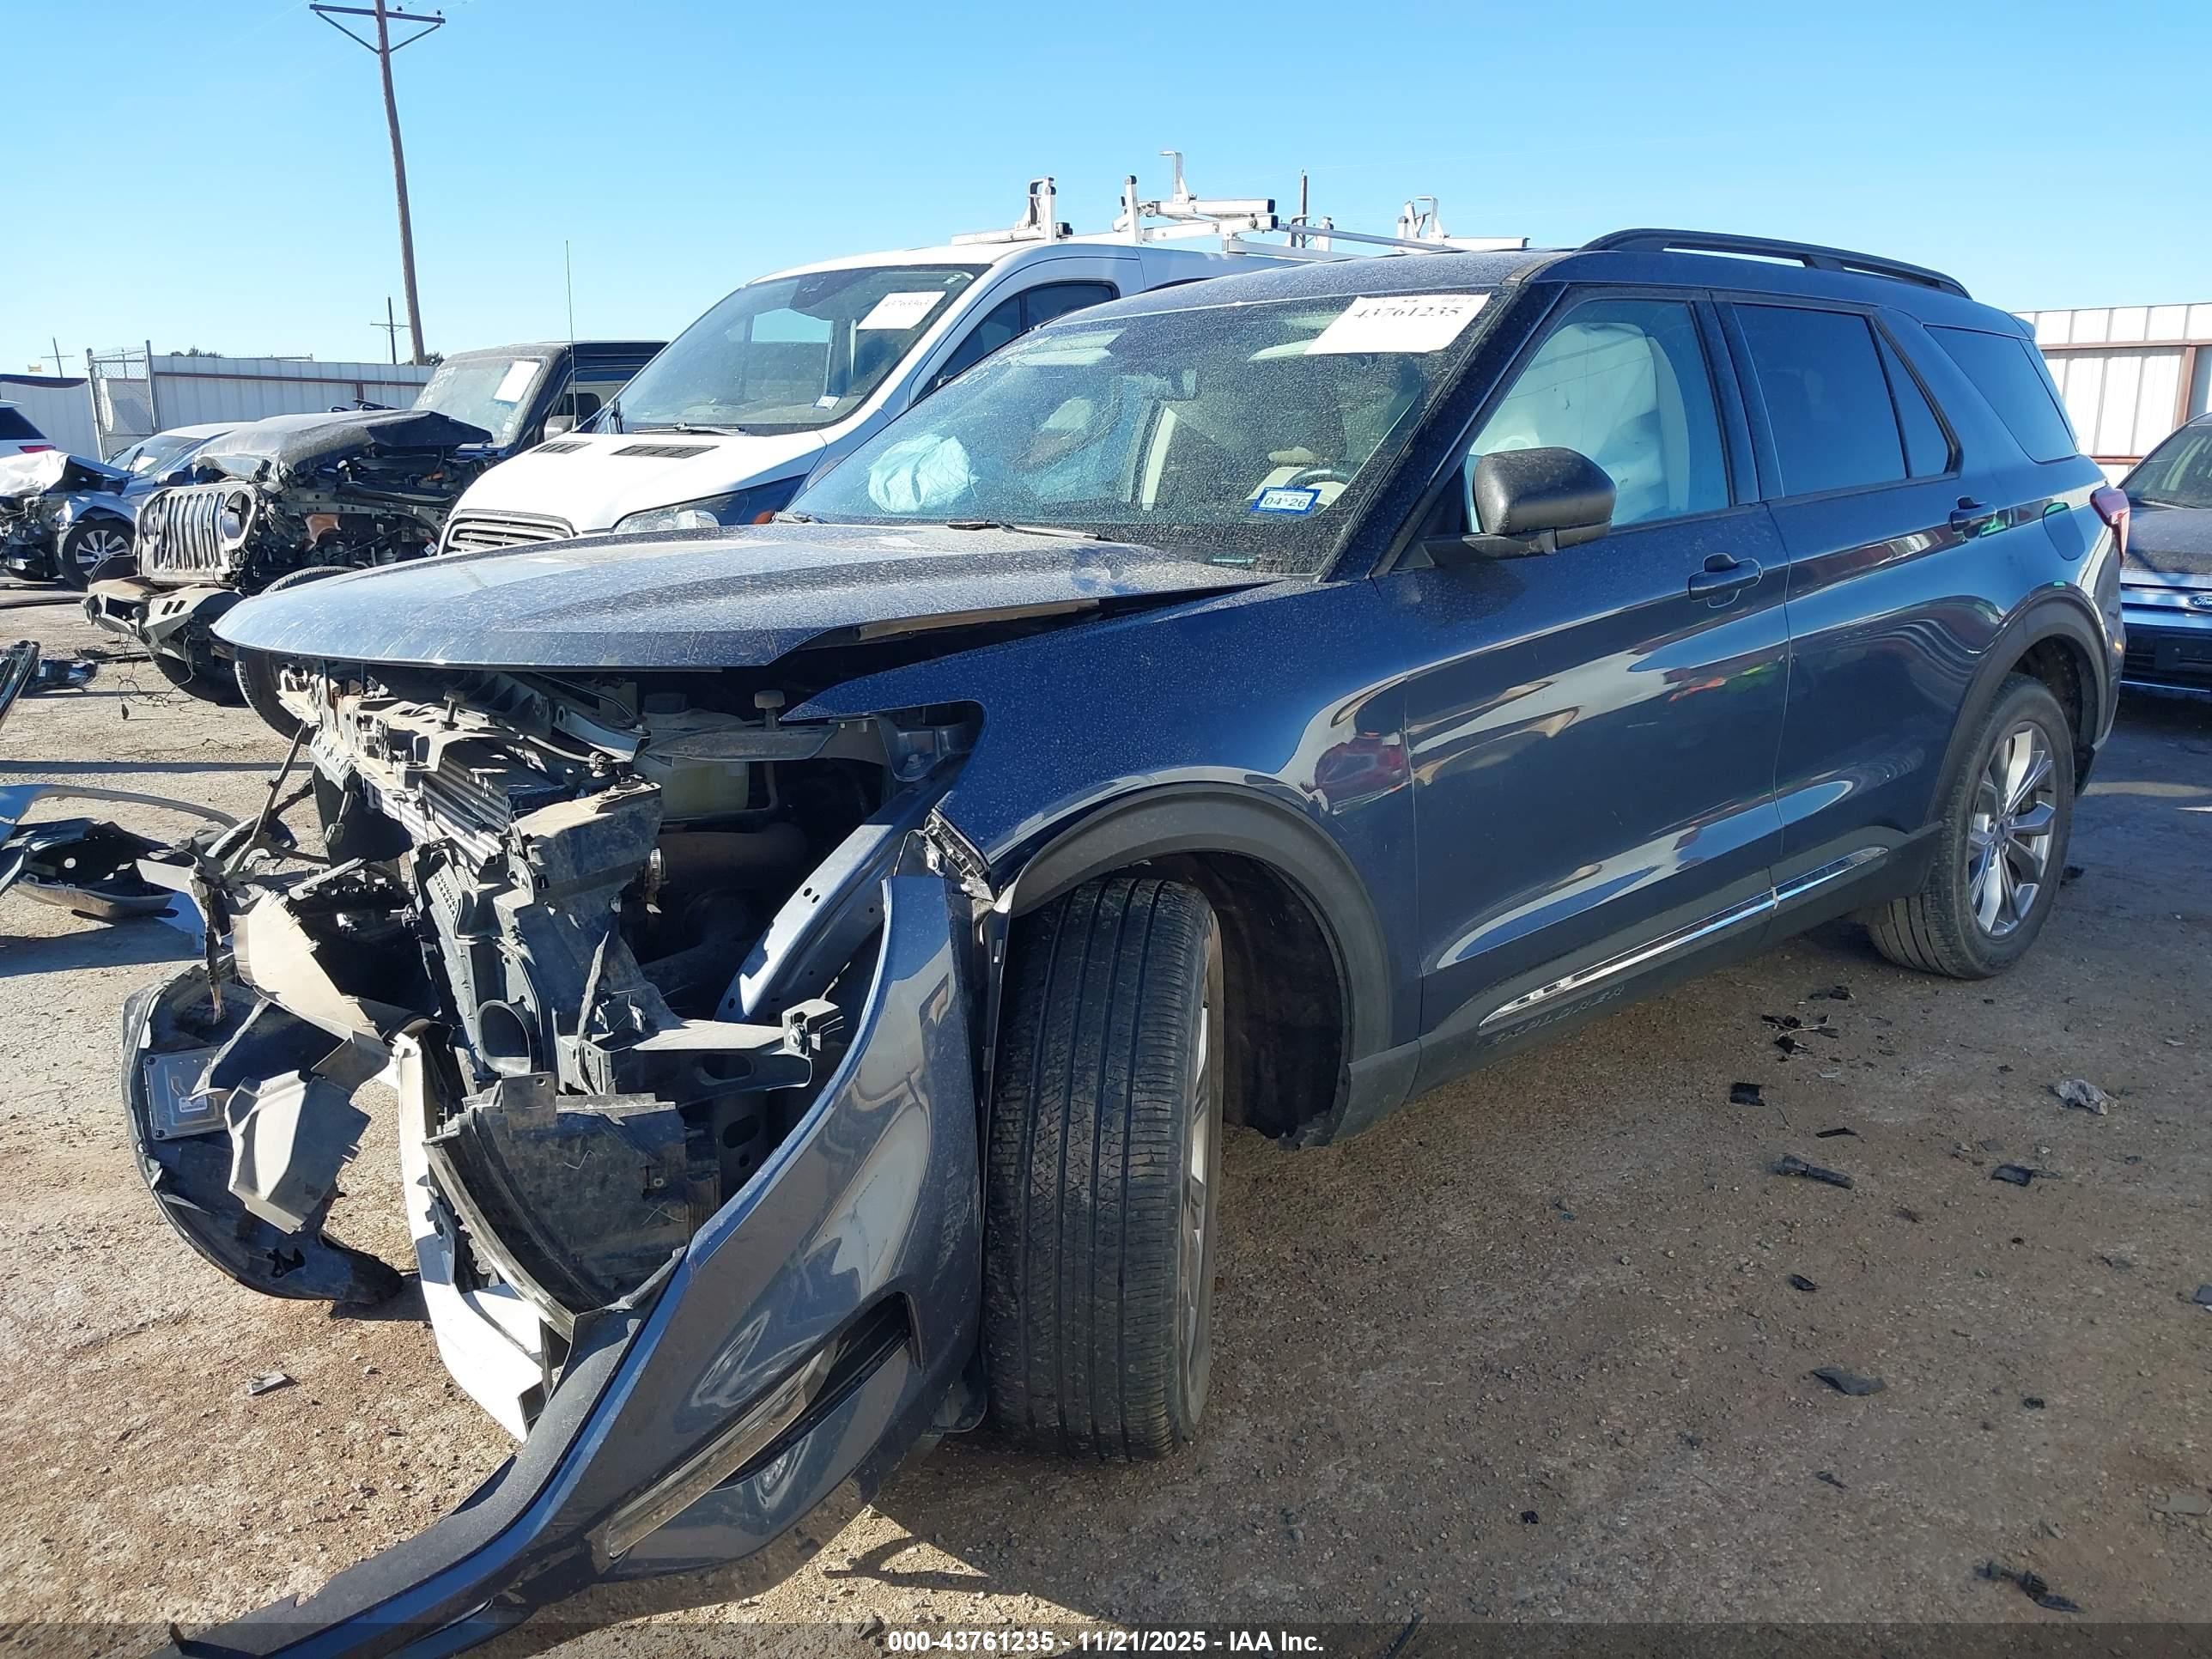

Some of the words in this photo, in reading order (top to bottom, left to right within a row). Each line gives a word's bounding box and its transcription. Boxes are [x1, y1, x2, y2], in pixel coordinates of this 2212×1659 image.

[1353, 307, 1462, 319] 43761235
[1264, 496, 1283, 506] 04
[1287, 497, 1308, 508] 26
